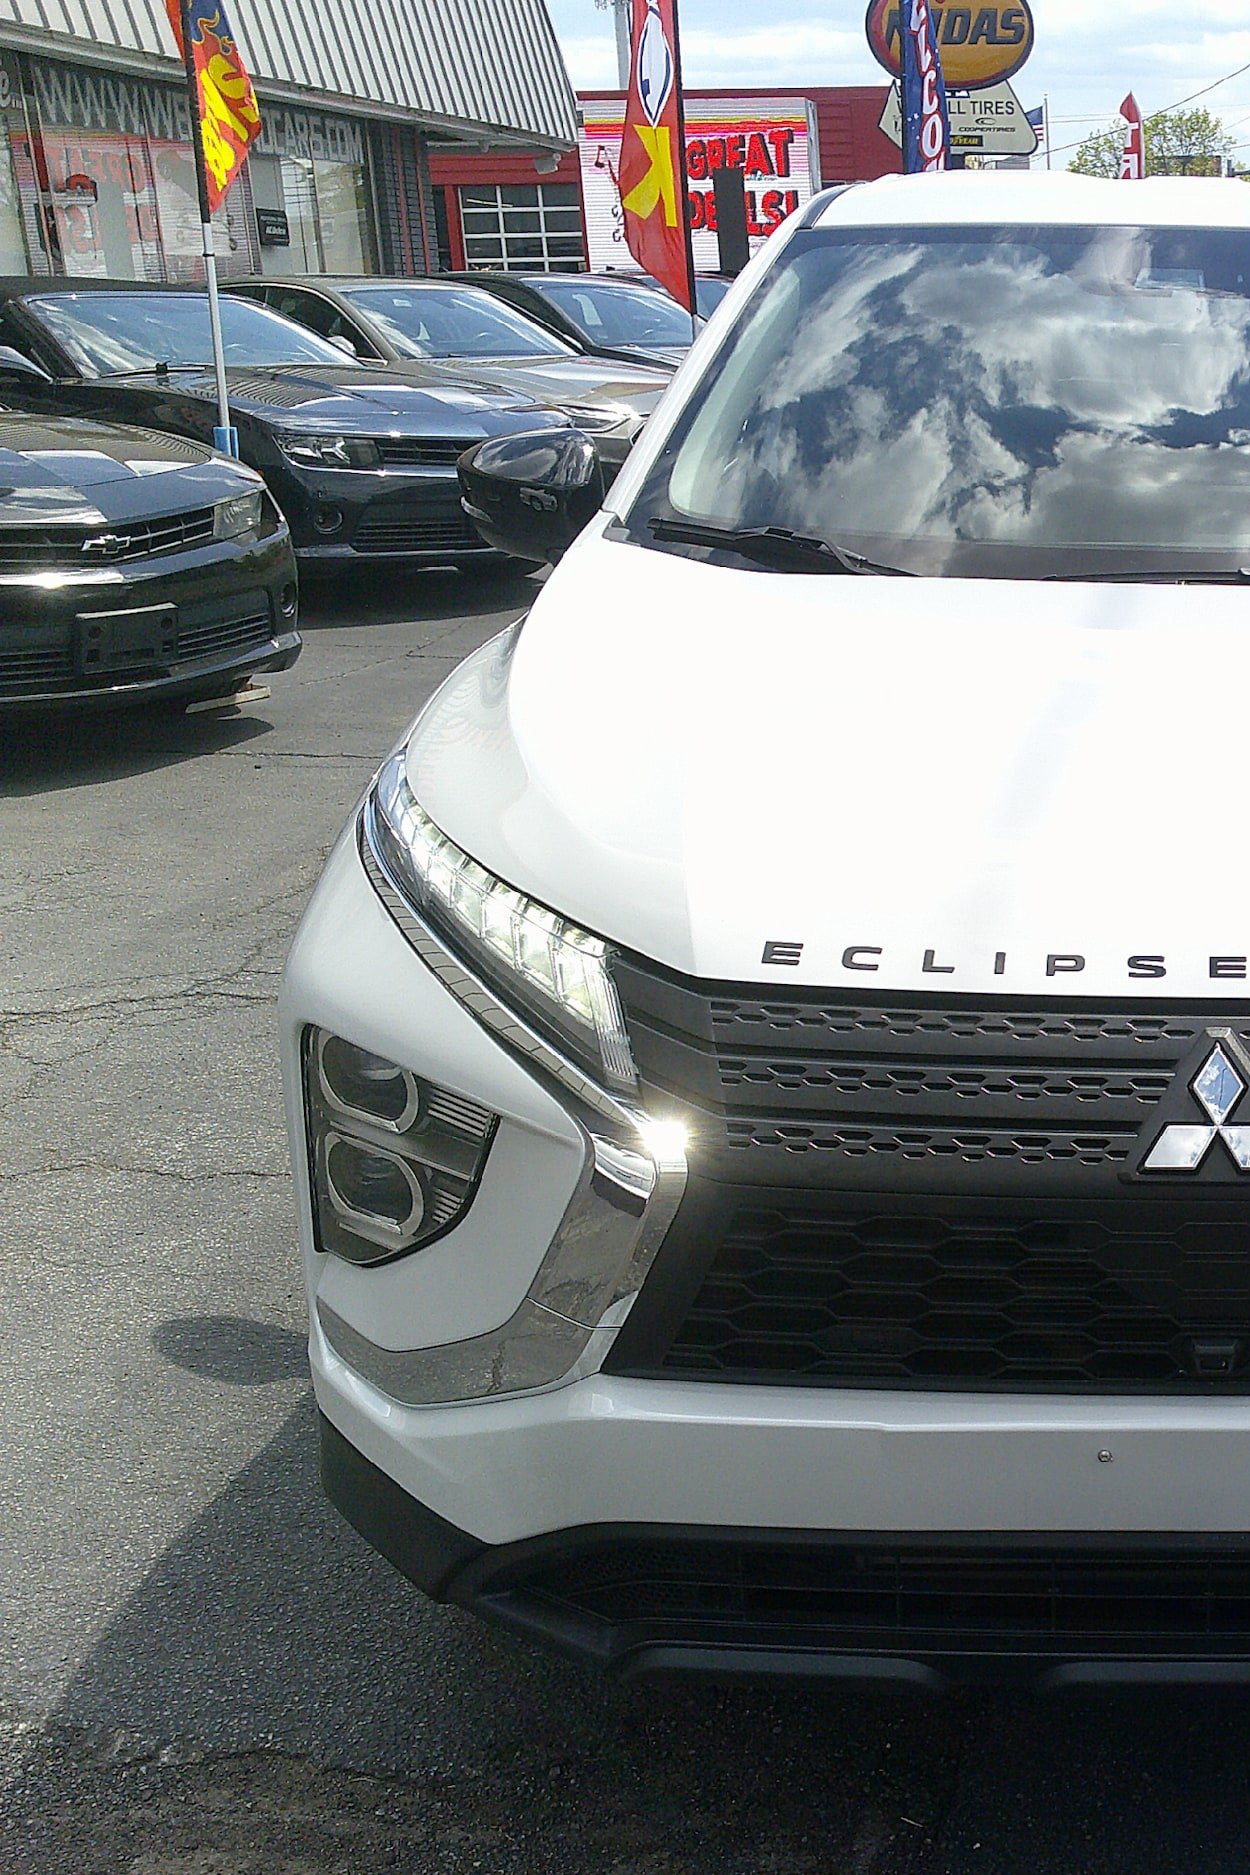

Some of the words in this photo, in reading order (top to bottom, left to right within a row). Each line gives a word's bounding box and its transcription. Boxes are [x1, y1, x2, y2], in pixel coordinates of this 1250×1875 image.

[970, 101, 1015, 114] TIRES
[686, 128, 794, 180] GREAT
[761, 941, 1247, 979] ECLIPSE
